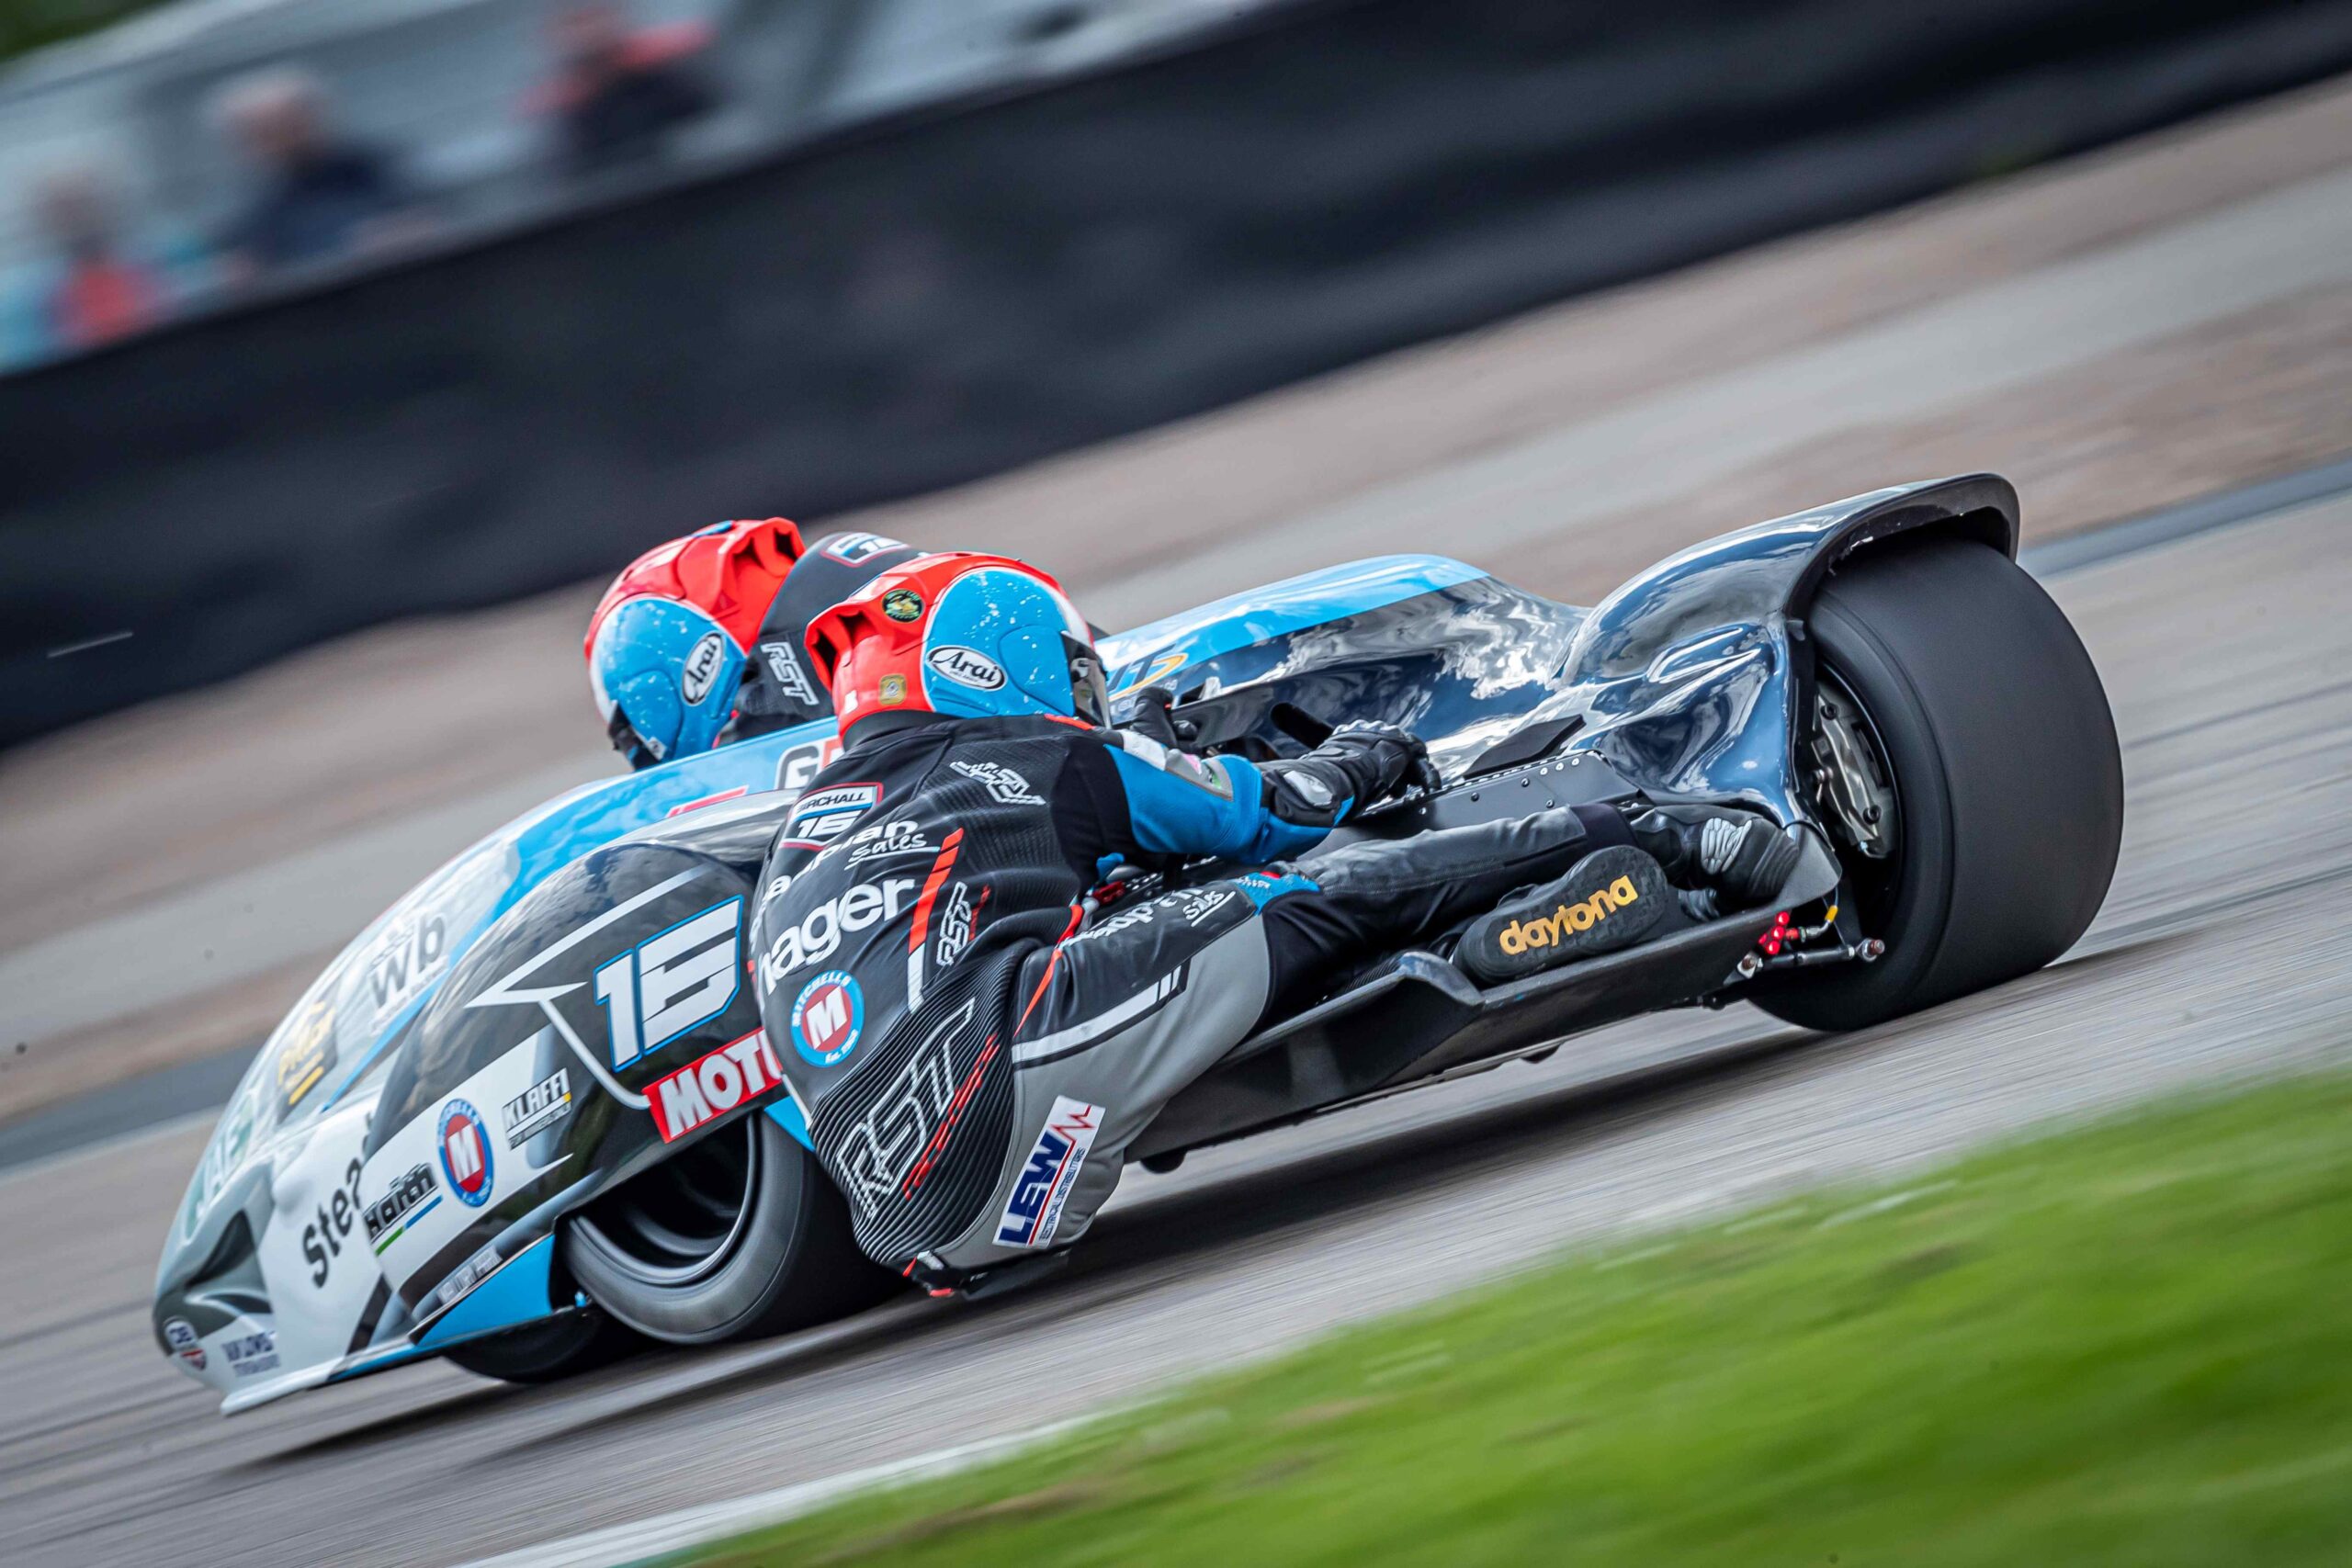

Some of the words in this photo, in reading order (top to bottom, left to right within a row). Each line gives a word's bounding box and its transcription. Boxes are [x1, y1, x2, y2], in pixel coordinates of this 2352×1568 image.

[686, 643, 718, 700] Arai
[760, 641, 820, 705] RST
[933, 651, 999, 682] Arai
[1498, 874, 1638, 955] daytona
[806, 985, 848, 1051] M
[998, 1130, 1071, 1245] LEW
